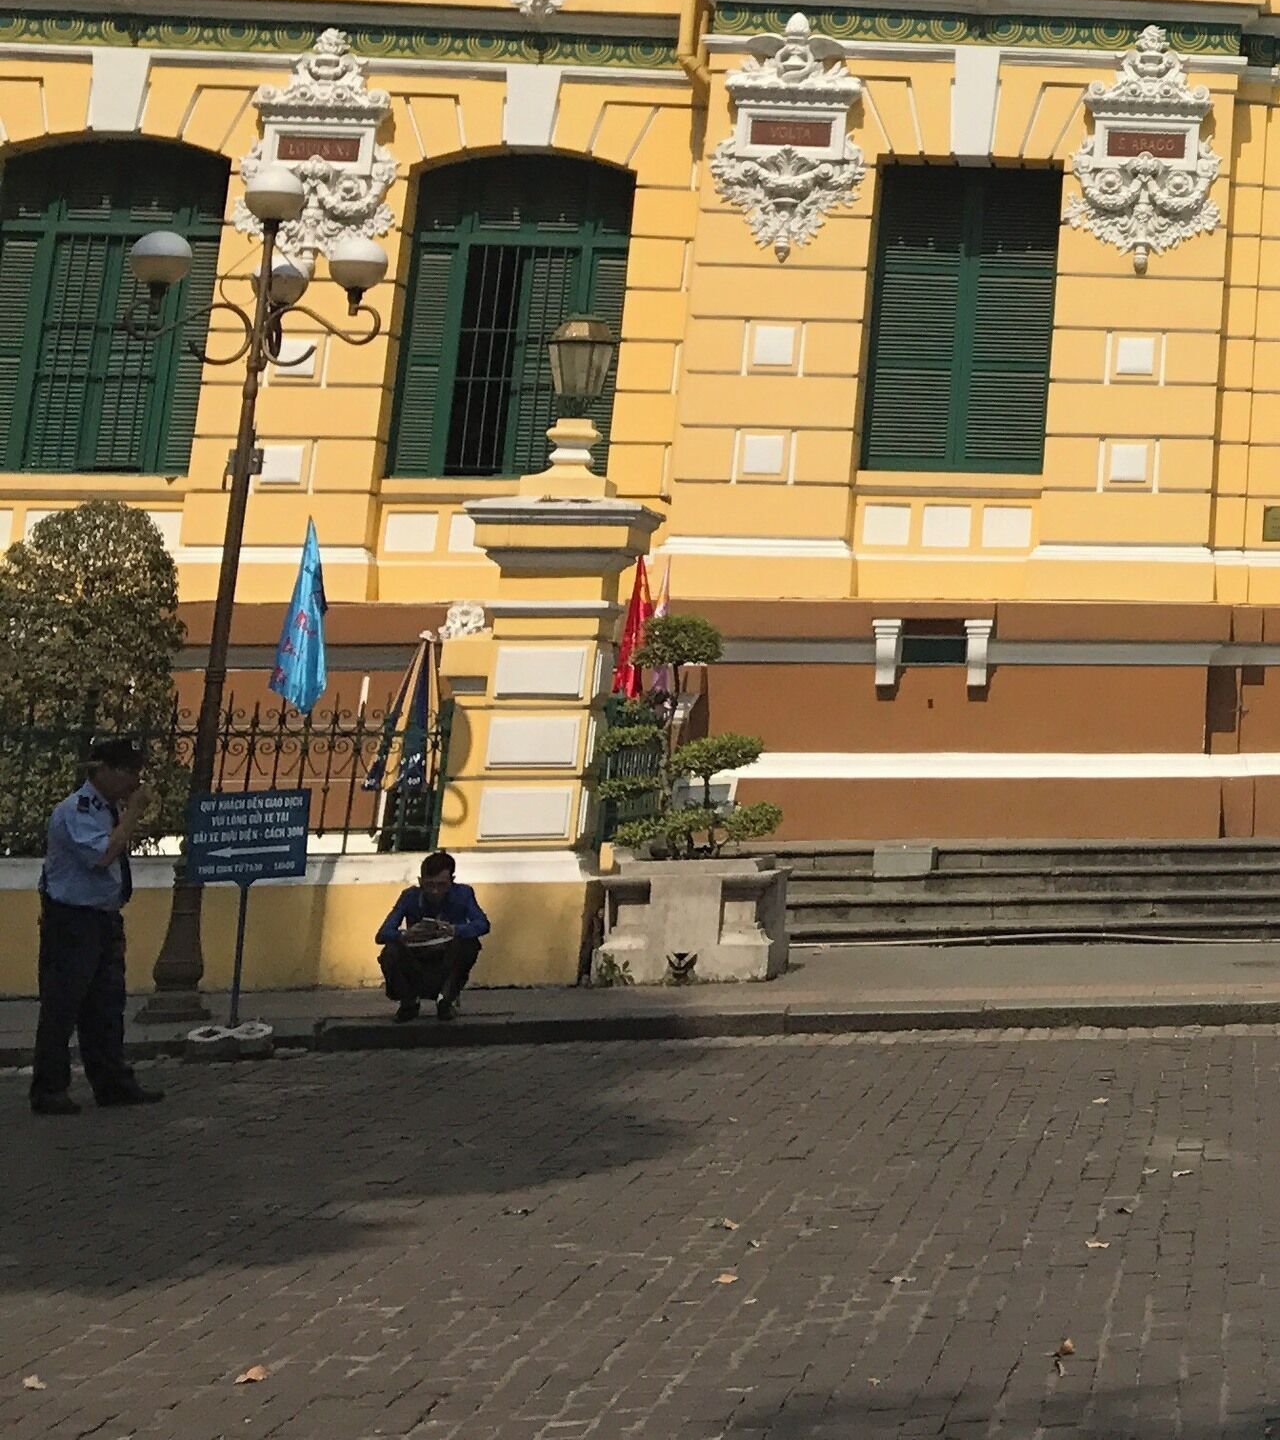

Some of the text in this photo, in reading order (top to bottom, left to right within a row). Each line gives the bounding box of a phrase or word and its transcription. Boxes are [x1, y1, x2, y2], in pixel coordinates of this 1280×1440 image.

[265, 797, 283, 809] GIAO
[264, 813, 273, 823] XE
[209, 833, 219, 842] XE
[264, 825, 285, 840] CÁCH
[286, 826, 304, 838] 30M
